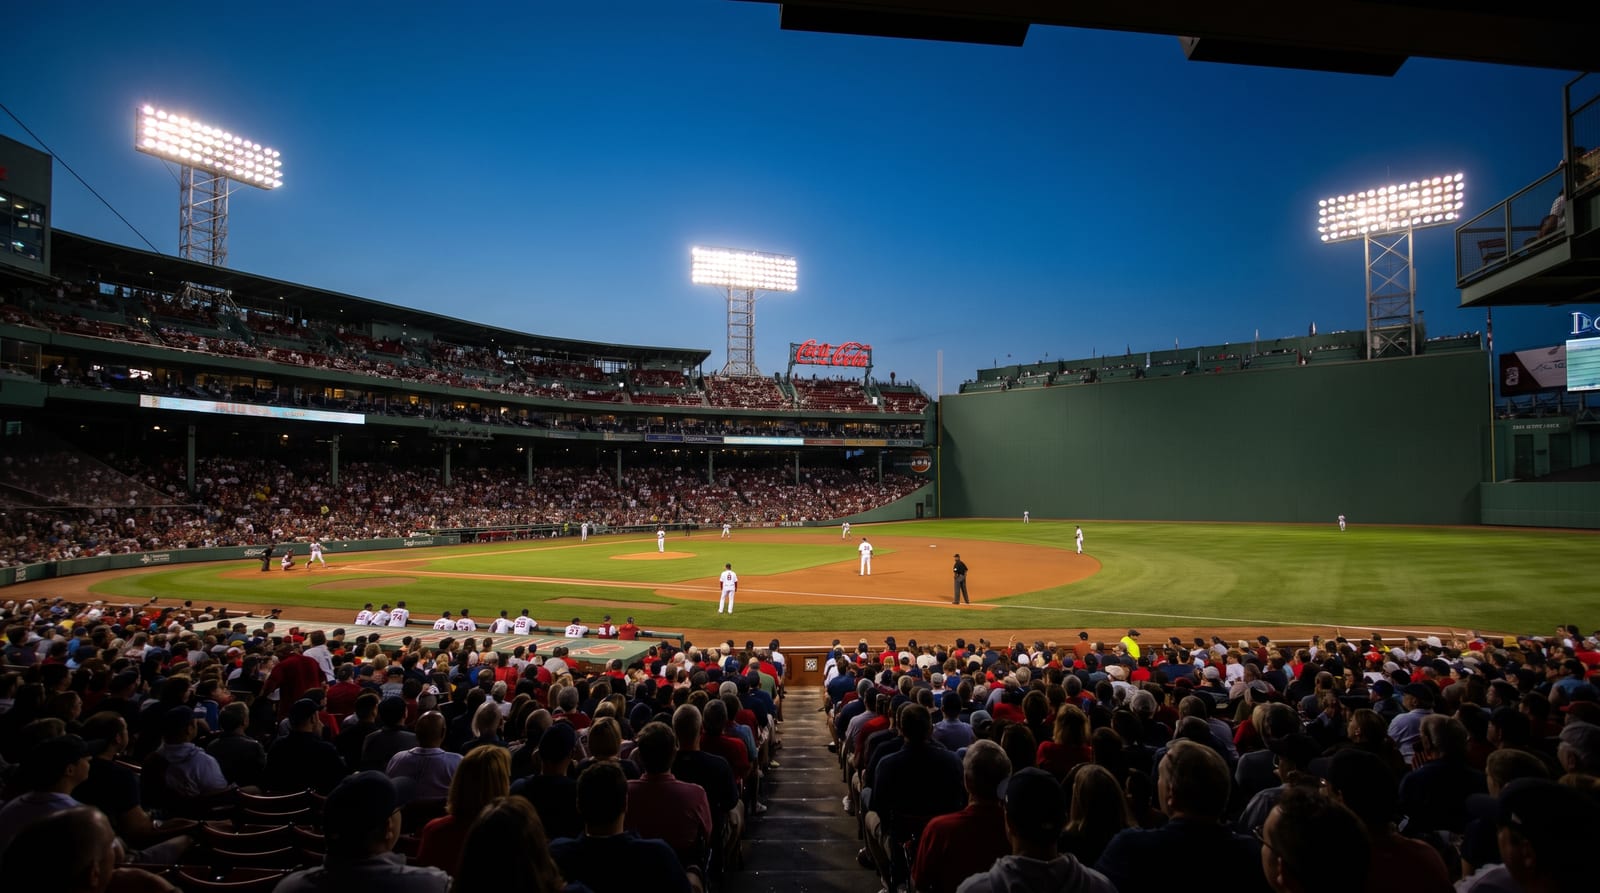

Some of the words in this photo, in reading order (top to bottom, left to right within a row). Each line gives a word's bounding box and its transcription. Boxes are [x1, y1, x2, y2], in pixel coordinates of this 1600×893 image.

[831, 341, 872, 367] Cola
[393, 613, 403, 621] 74
[568, 628, 579, 636] 21
